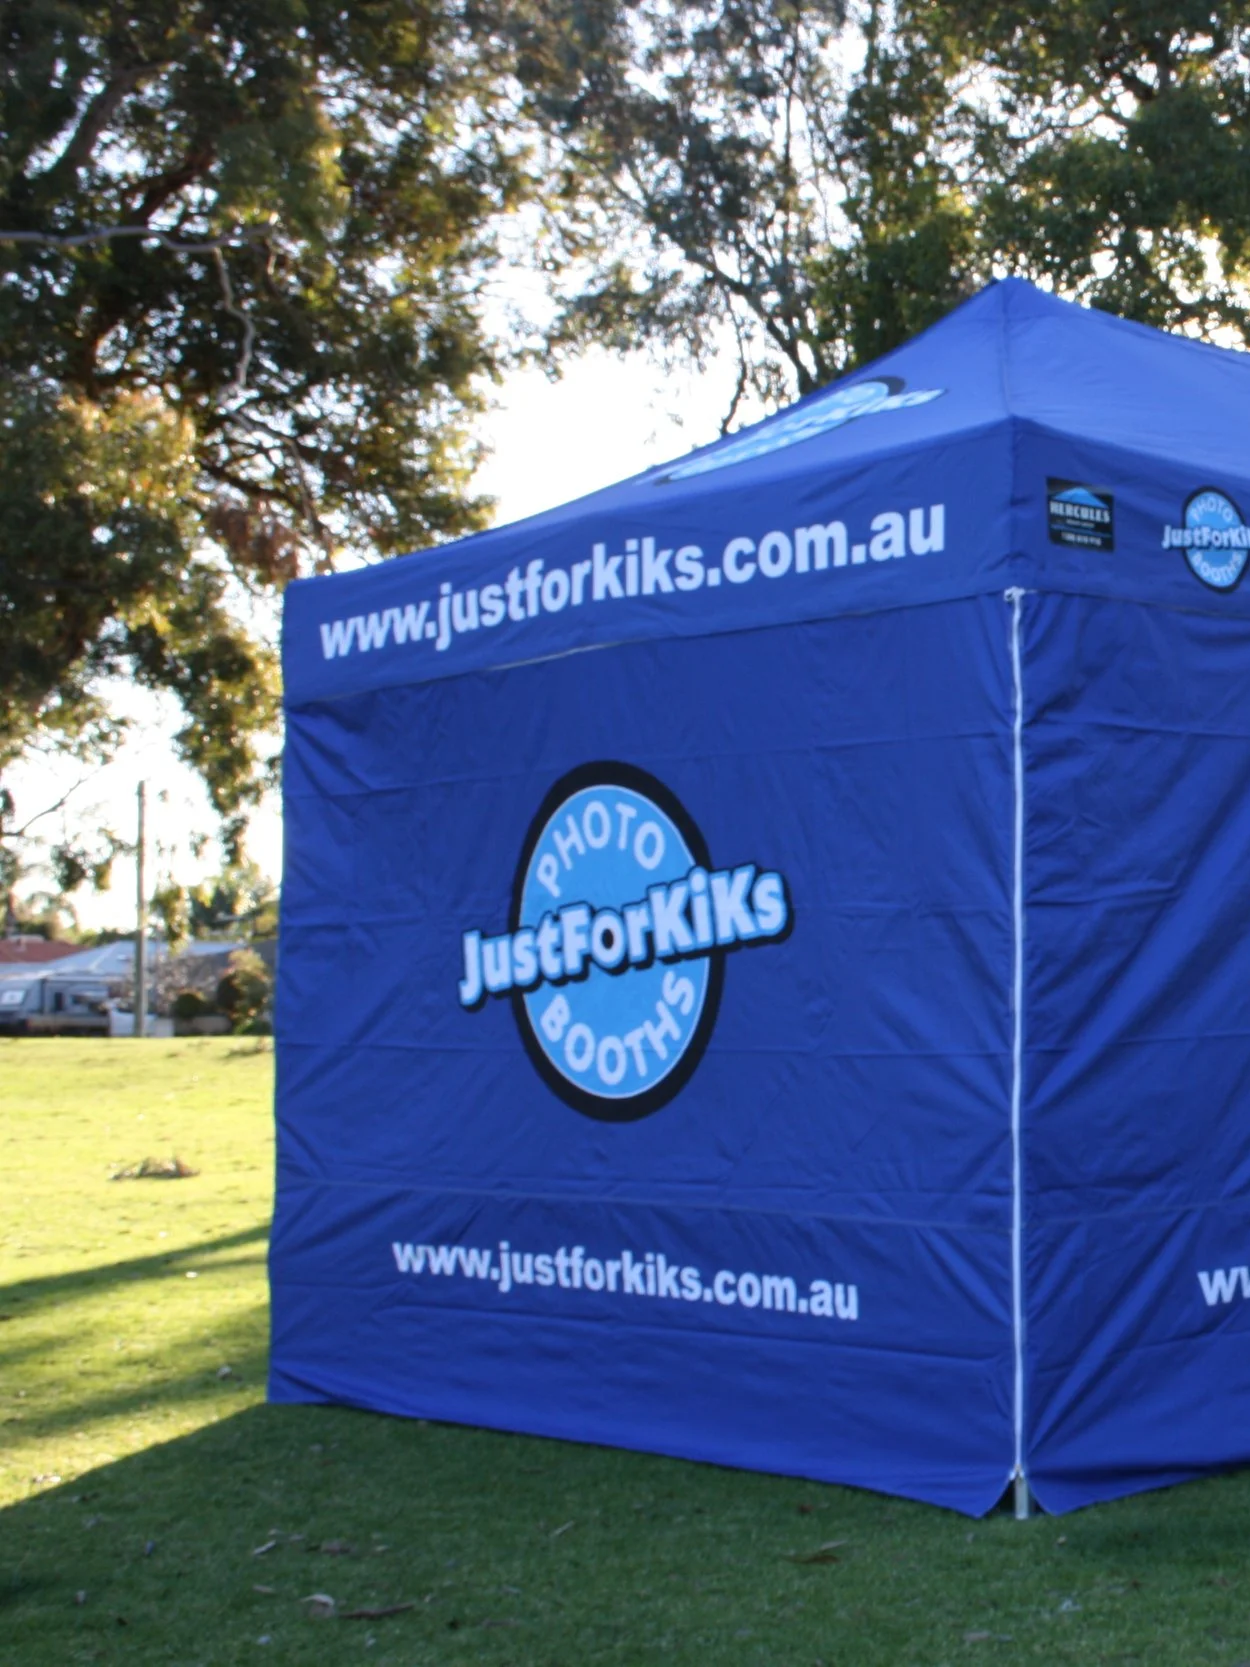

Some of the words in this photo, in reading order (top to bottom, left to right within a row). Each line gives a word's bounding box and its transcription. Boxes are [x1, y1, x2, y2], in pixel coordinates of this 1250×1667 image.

[320, 503, 946, 660] www.justforkiks.com.au
[536, 801, 665, 898] PHOTO
[459, 863, 788, 1006] JustForKiKs
[540, 970, 695, 1085] BOOTHS
[393, 1241, 858, 1320] www.justforkiks.com.au
